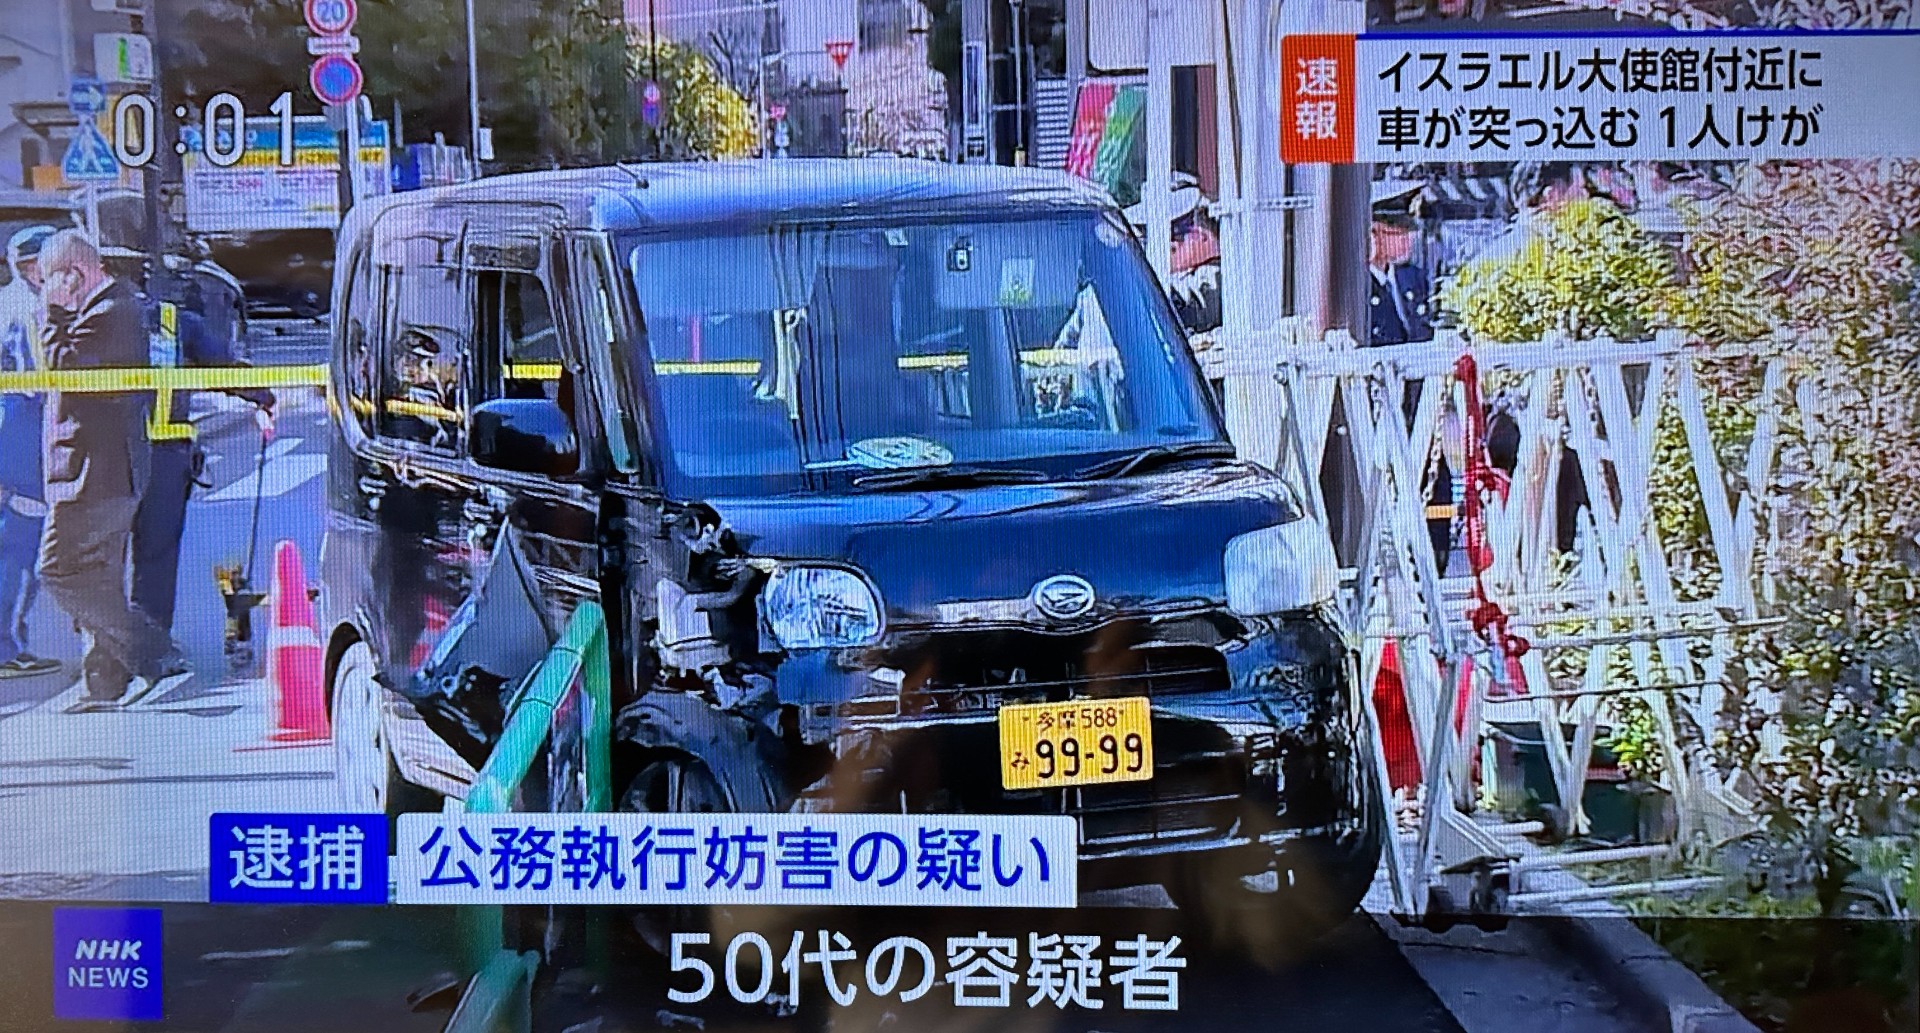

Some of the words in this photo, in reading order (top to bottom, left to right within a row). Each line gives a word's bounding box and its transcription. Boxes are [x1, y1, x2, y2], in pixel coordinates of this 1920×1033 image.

[317, 1, 346, 22] 20
[1377, 47, 1824, 94] イスラエル大使館付近に
[1295, 57, 1338, 140] 速報
[115, 92, 293, 167] 0:01
[1377, 105, 1638, 151] 車が突っ込む
[1659, 104, 1824, 150] 1人けが
[1081, 707, 1117, 728] 588
[1035, 733, 1143, 778] 99-99
[229, 824, 365, 891] 逮捕
[420, 826, 1051, 892] 公務執行妨害の疑い
[75, 939, 142, 961] NHK
[667, 930, 1187, 1011] 50代の容疑者
[68, 966, 149, 989] NEWS
